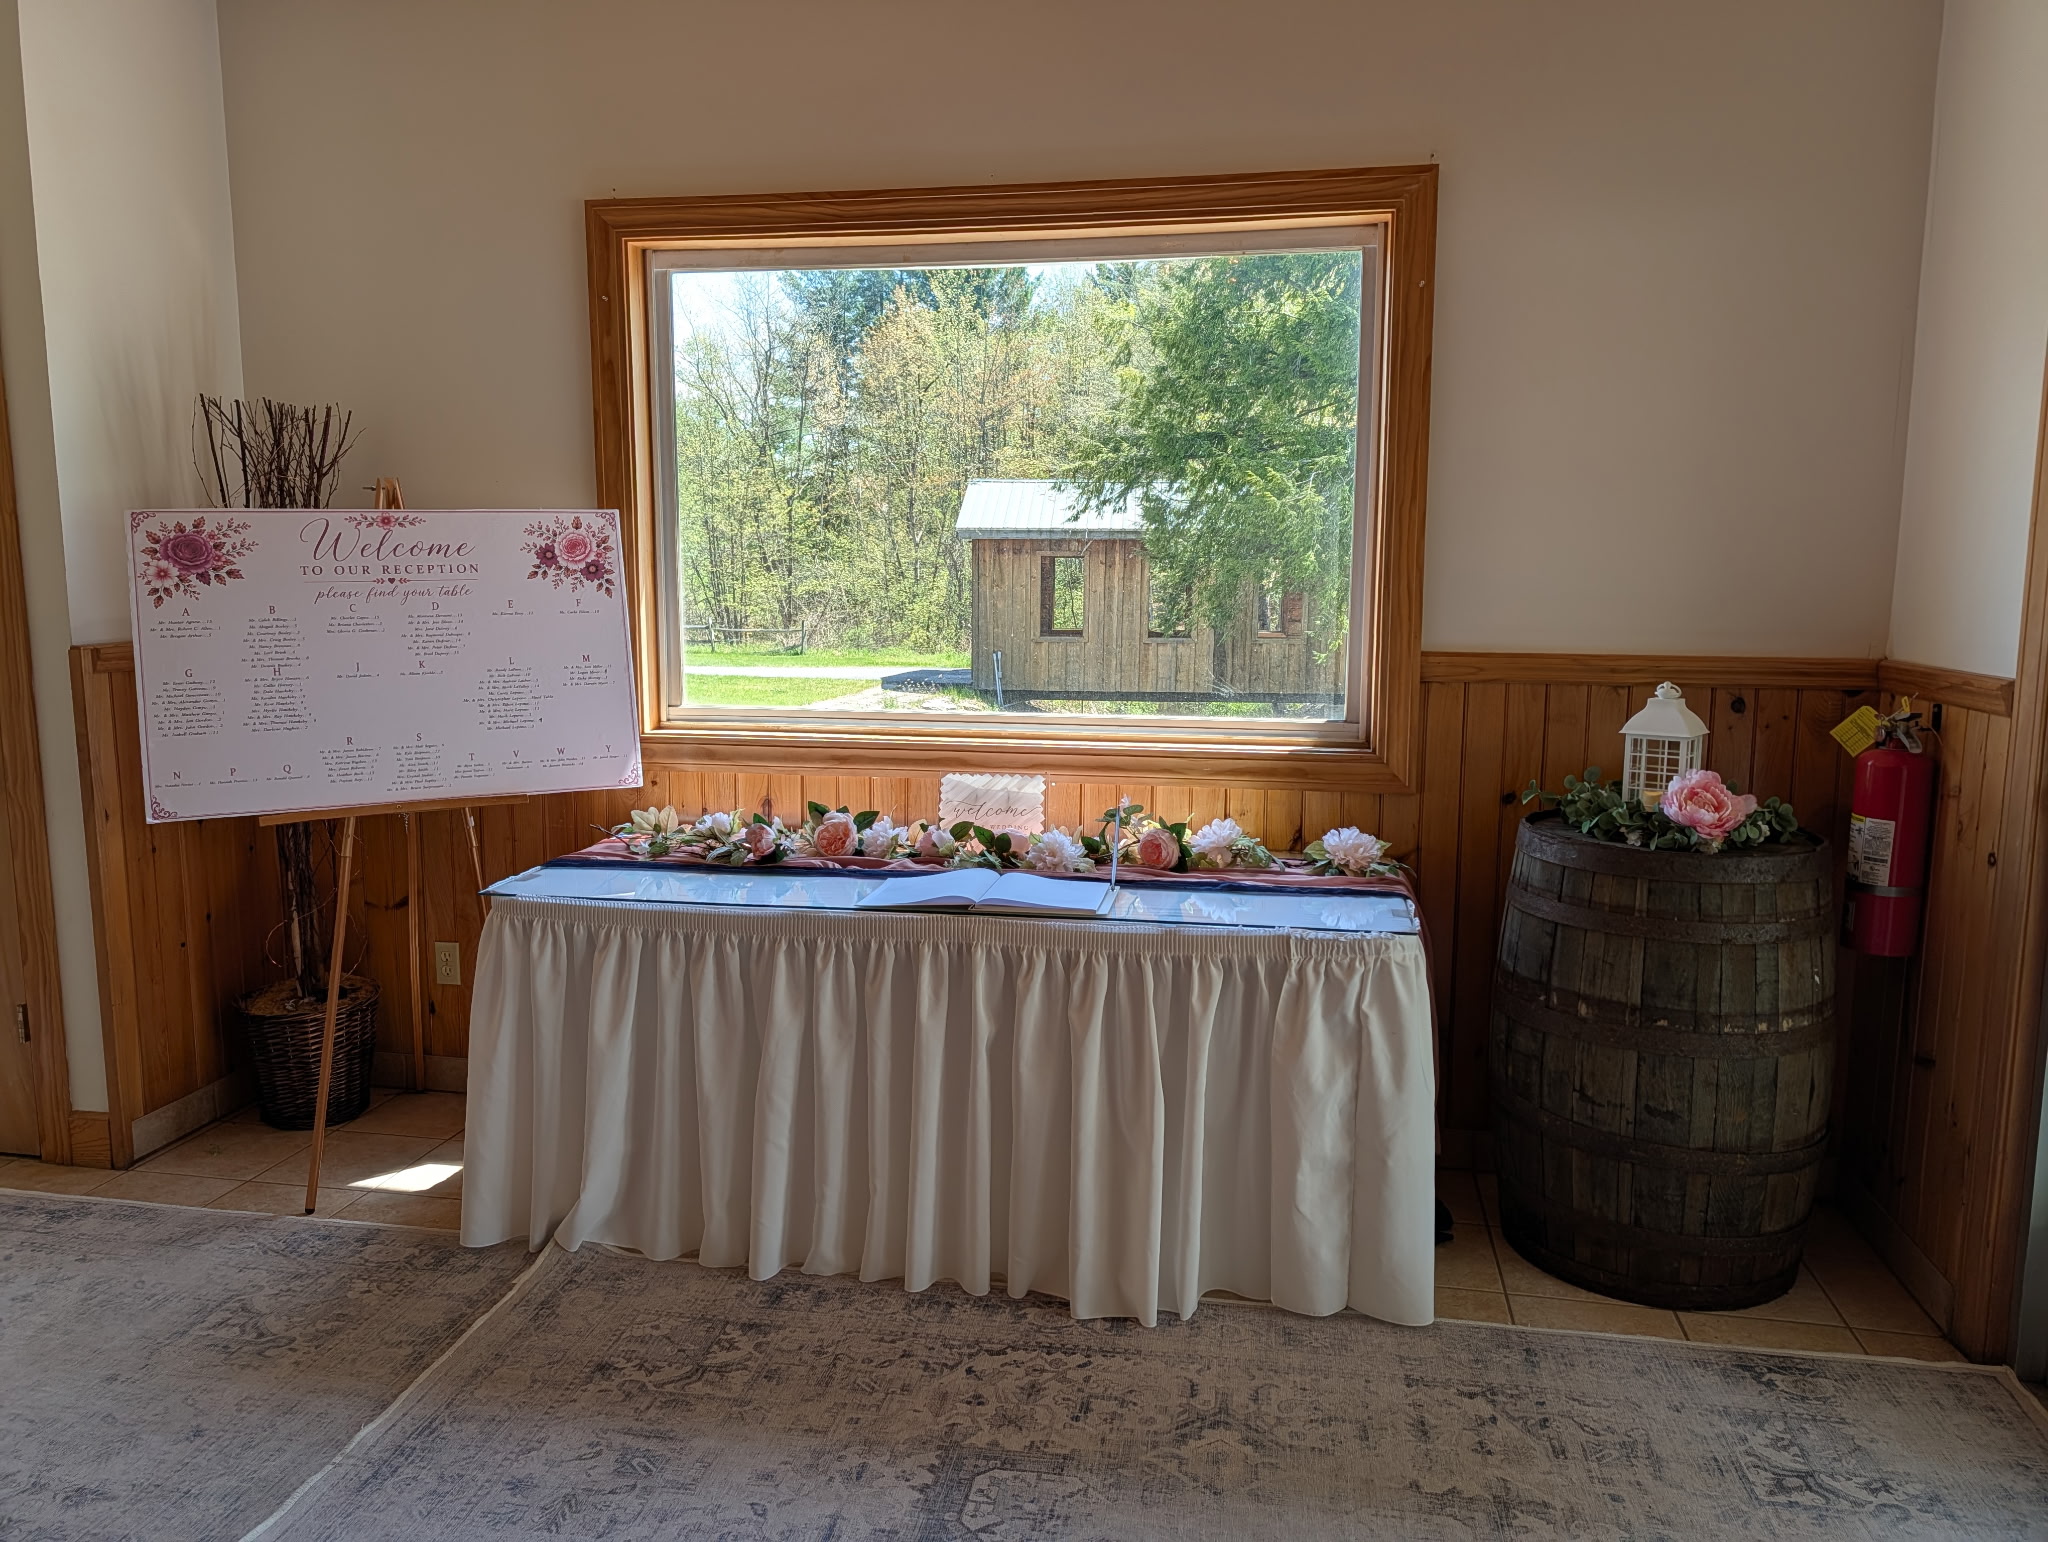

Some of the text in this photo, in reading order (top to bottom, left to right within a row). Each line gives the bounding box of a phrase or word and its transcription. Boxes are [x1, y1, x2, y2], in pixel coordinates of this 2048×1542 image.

[300, 517, 476, 562] Welcome
[300, 564, 480, 575] TO OUR RECEPTION
[314, 583, 473, 605] please find your table
[432, 602, 439, 611] D
[508, 599, 514, 609] E
[576, 599, 581, 607] F
[182, 607, 190, 616] A
[269, 605, 276, 614] B
[349, 603, 357, 613] C
[509, 657, 515, 665] L
[582, 654, 591, 662] M
[419, 660, 425, 669] K
[185, 668, 193, 678] G
[273, 667, 281, 676] H
[346, 736, 354, 745] R
[416, 732, 422, 741] S
[556, 747, 566, 755] W
[605, 744, 611, 753] Y
[468, 752, 475, 761] T
[513, 750, 520, 758] V
[230, 768, 237, 776] P
[283, 765, 292, 774] Q
[173, 772, 181, 780] N
[946, 800, 1041, 820] welcome
